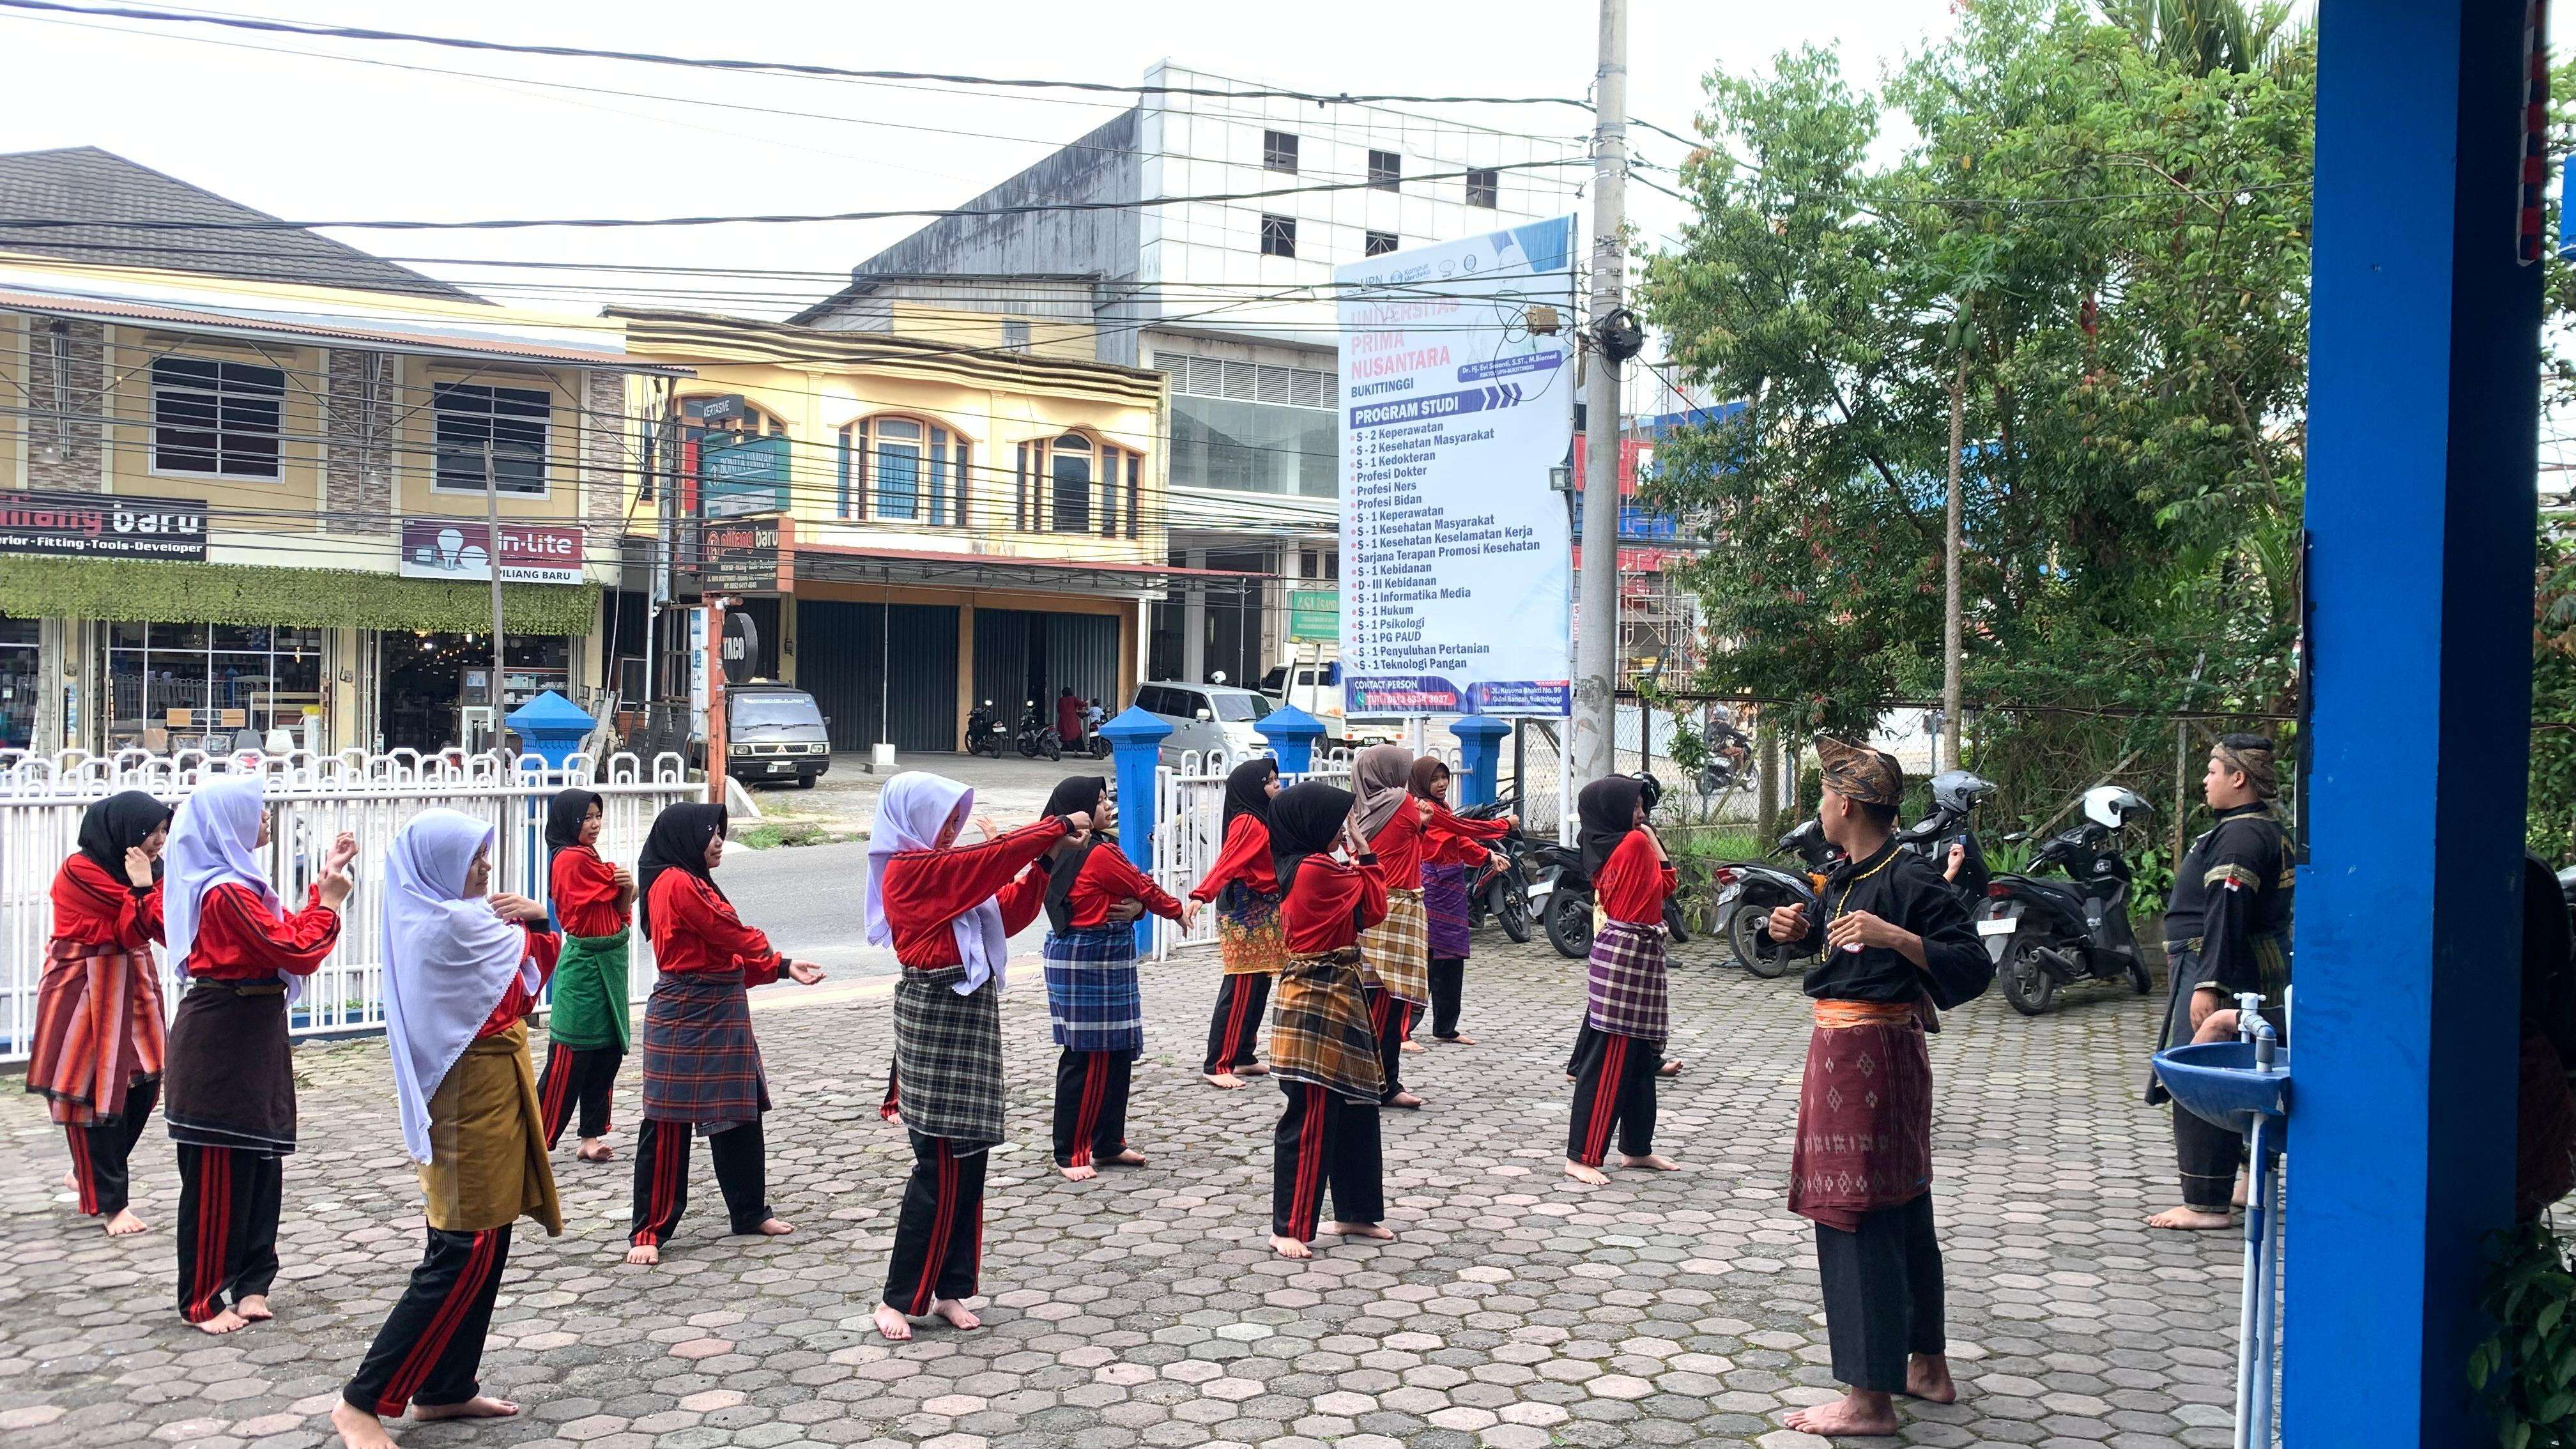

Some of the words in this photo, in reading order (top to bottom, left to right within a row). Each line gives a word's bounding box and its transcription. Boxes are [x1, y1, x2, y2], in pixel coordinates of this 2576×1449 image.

[1351, 330, 1404, 355] PRIMA
[1352, 346, 1450, 379] NUSANTARA
[1351, 378, 1413, 397] BUKITTINGGI
[703, 399, 730, 418] KERTASIVE
[1355, 402, 1418, 424] PROGRAM
[1421, 396, 1459, 415] STUDI
[1357, 432, 1363, 441] S
[1370, 430, 1376, 440] 2
[1379, 422, 1443, 440] Keperawatan
[1357, 445, 1363, 456] S
[1370, 444, 1376, 454] 2
[1379, 438, 1431, 453] Kesehatan
[1434, 427, 1494, 446] Masyarakat
[720, 454, 746, 474] BONITA
[1357, 459, 1363, 469] S
[1371, 457, 1376, 467] 1
[1379, 452, 1436, 466] Kedokteran
[1357, 469, 1391, 482] Profesi
[1394, 466, 1427, 479] Dokter
[1357, 482, 1391, 496] Profesi
[1394, 481, 1416, 492] Ners
[1357, 496, 1392, 509] Profesi
[1394, 494, 1422, 505] Bidan
[113, 500, 198, 535] baru
[1357, 513, 1363, 523] S
[1371, 512, 1377, 521] 1
[1379, 506, 1444, 521] Keperawatan
[1357, 526, 1363, 536] S
[1371, 525, 1377, 535] 1
[1380, 521, 1432, 535] Kesehatan
[1434, 514, 1494, 530] Masyarakat
[498, 532, 572, 554] in-lite
[755, 526, 778, 548] baru
[1358, 540, 1363, 549] S
[1372, 539, 1377, 548] 1
[1380, 535, 1432, 548] Kesehatan
[1435, 529, 1501, 544] Keselamatan
[1505, 525, 1533, 539] Kerja
[1358, 552, 1394, 564] Sarjana
[1397, 549, 1436, 561] Terapan
[1438, 544, 1480, 557] Promosi
[1483, 540, 1540, 554] Kesehatan
[542, 572, 571, 580] BARU
[1358, 567, 1364, 576] S
[1372, 565, 1377, 575] 1
[1380, 564, 1432, 575] Kebidanan
[1358, 580, 1365, 590] D
[1372, 579, 1382, 589] III
[1384, 577, 1437, 588] Kebidanan
[1358, 594, 1364, 604] S
[1372, 593, 1377, 602] 1
[1380, 589, 1438, 602] Informatika
[1440, 587, 1471, 599] Media
[1358, 607, 1364, 617] S
[1372, 606, 1377, 616] 1
[1380, 605, 1413, 616] Hukum
[1358, 620, 1364, 630] S
[1372, 620, 1377, 629] 1
[1380, 617, 1425, 629] Psikologi
[1358, 634, 1364, 643] S
[1372, 633, 1377, 643] 1
[1380, 632, 1393, 642] PG
[1395, 631, 1422, 642] PAUD
[724, 636, 744, 660] TACO
[1359, 647, 1365, 657] S
[1372, 647, 1377, 656] 1
[1380, 645, 1436, 657] Penyuluhan
[1439, 643, 1489, 654] Pertanian
[1360, 661, 1365, 670] S
[1374, 660, 1379, 670] 1
[1381, 659, 1427, 671] Teknologi
[1430, 658, 1467, 670] Pangan
[1354, 681, 1386, 689] CONTACT
[1388, 680, 1418, 689] PERSON
[1530, 695, 1563, 703] Bukittinggi
